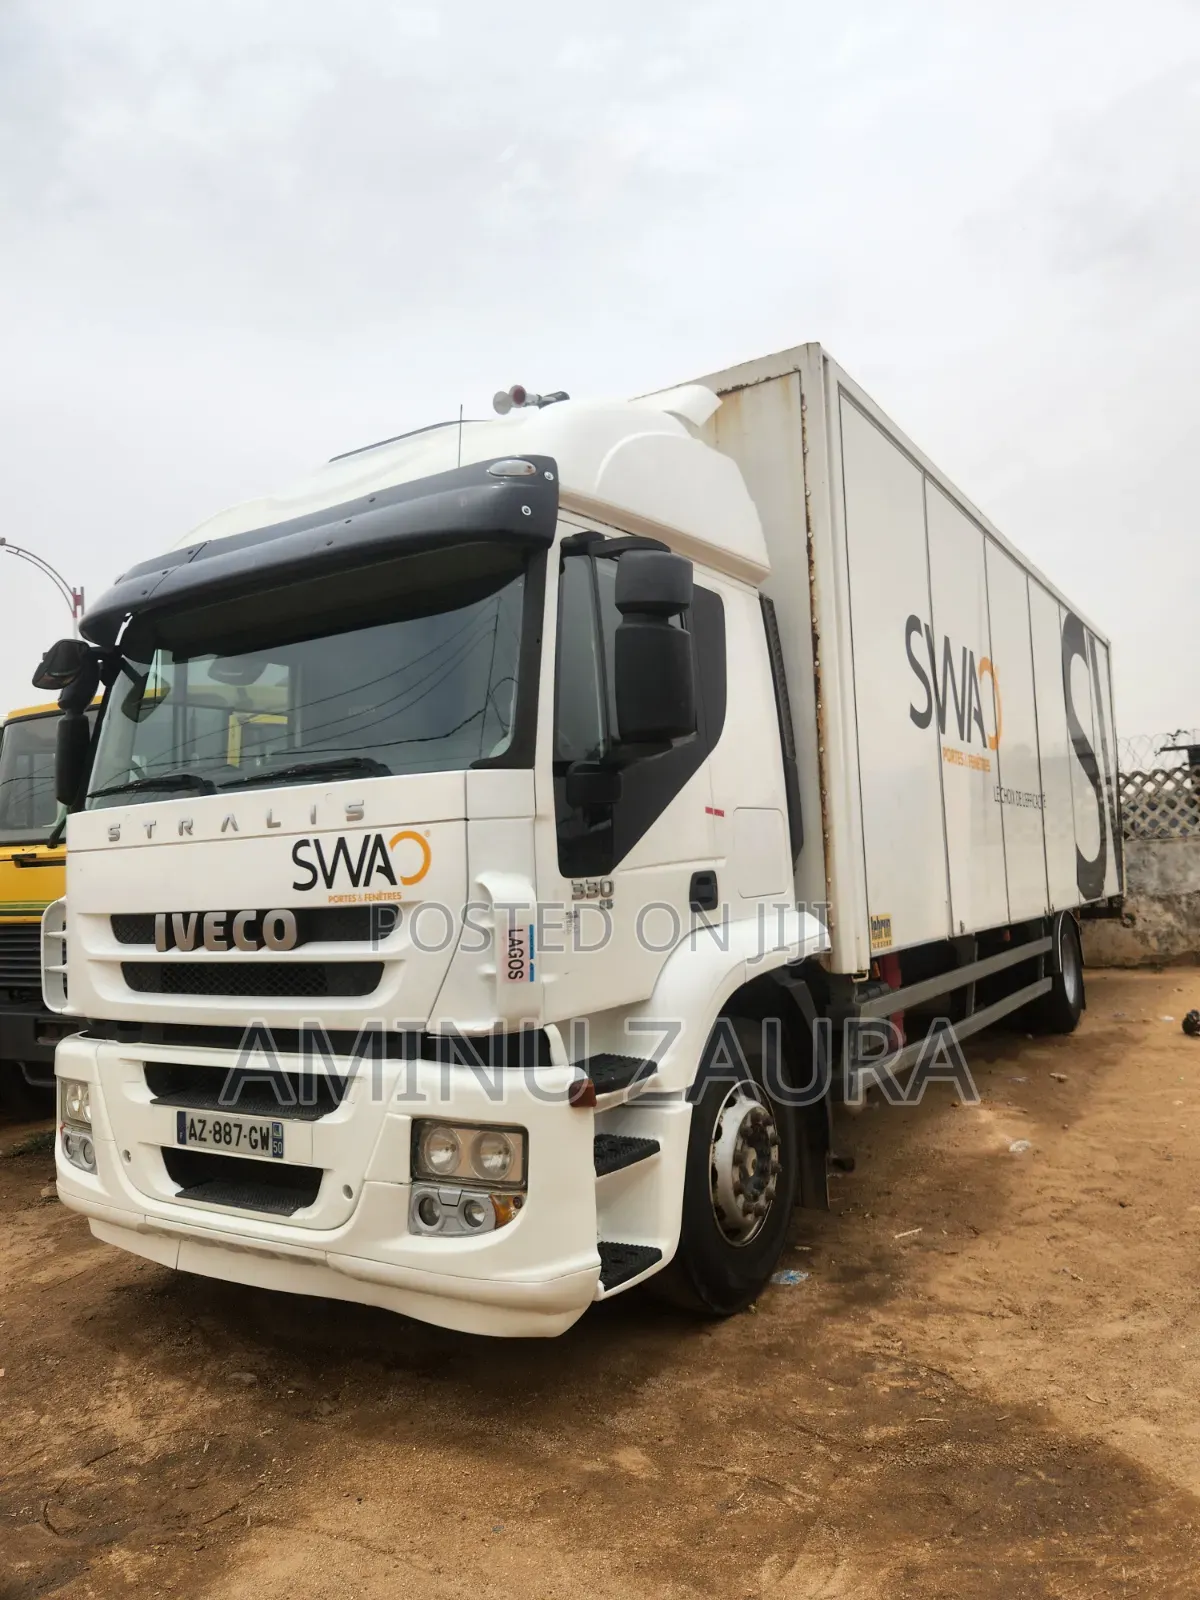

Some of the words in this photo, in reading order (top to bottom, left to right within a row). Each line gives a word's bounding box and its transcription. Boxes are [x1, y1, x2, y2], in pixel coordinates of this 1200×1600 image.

[107, 799, 365, 842] STRALIS
[328, 894, 357, 903] PORTES
[364, 890, 402, 901] FENÊTRES
[571, 877, 614, 901] 330
[154, 908, 298, 952] IVECO
[507, 928, 525, 980] LAGOS
[272, 1140, 283, 1154] 50
